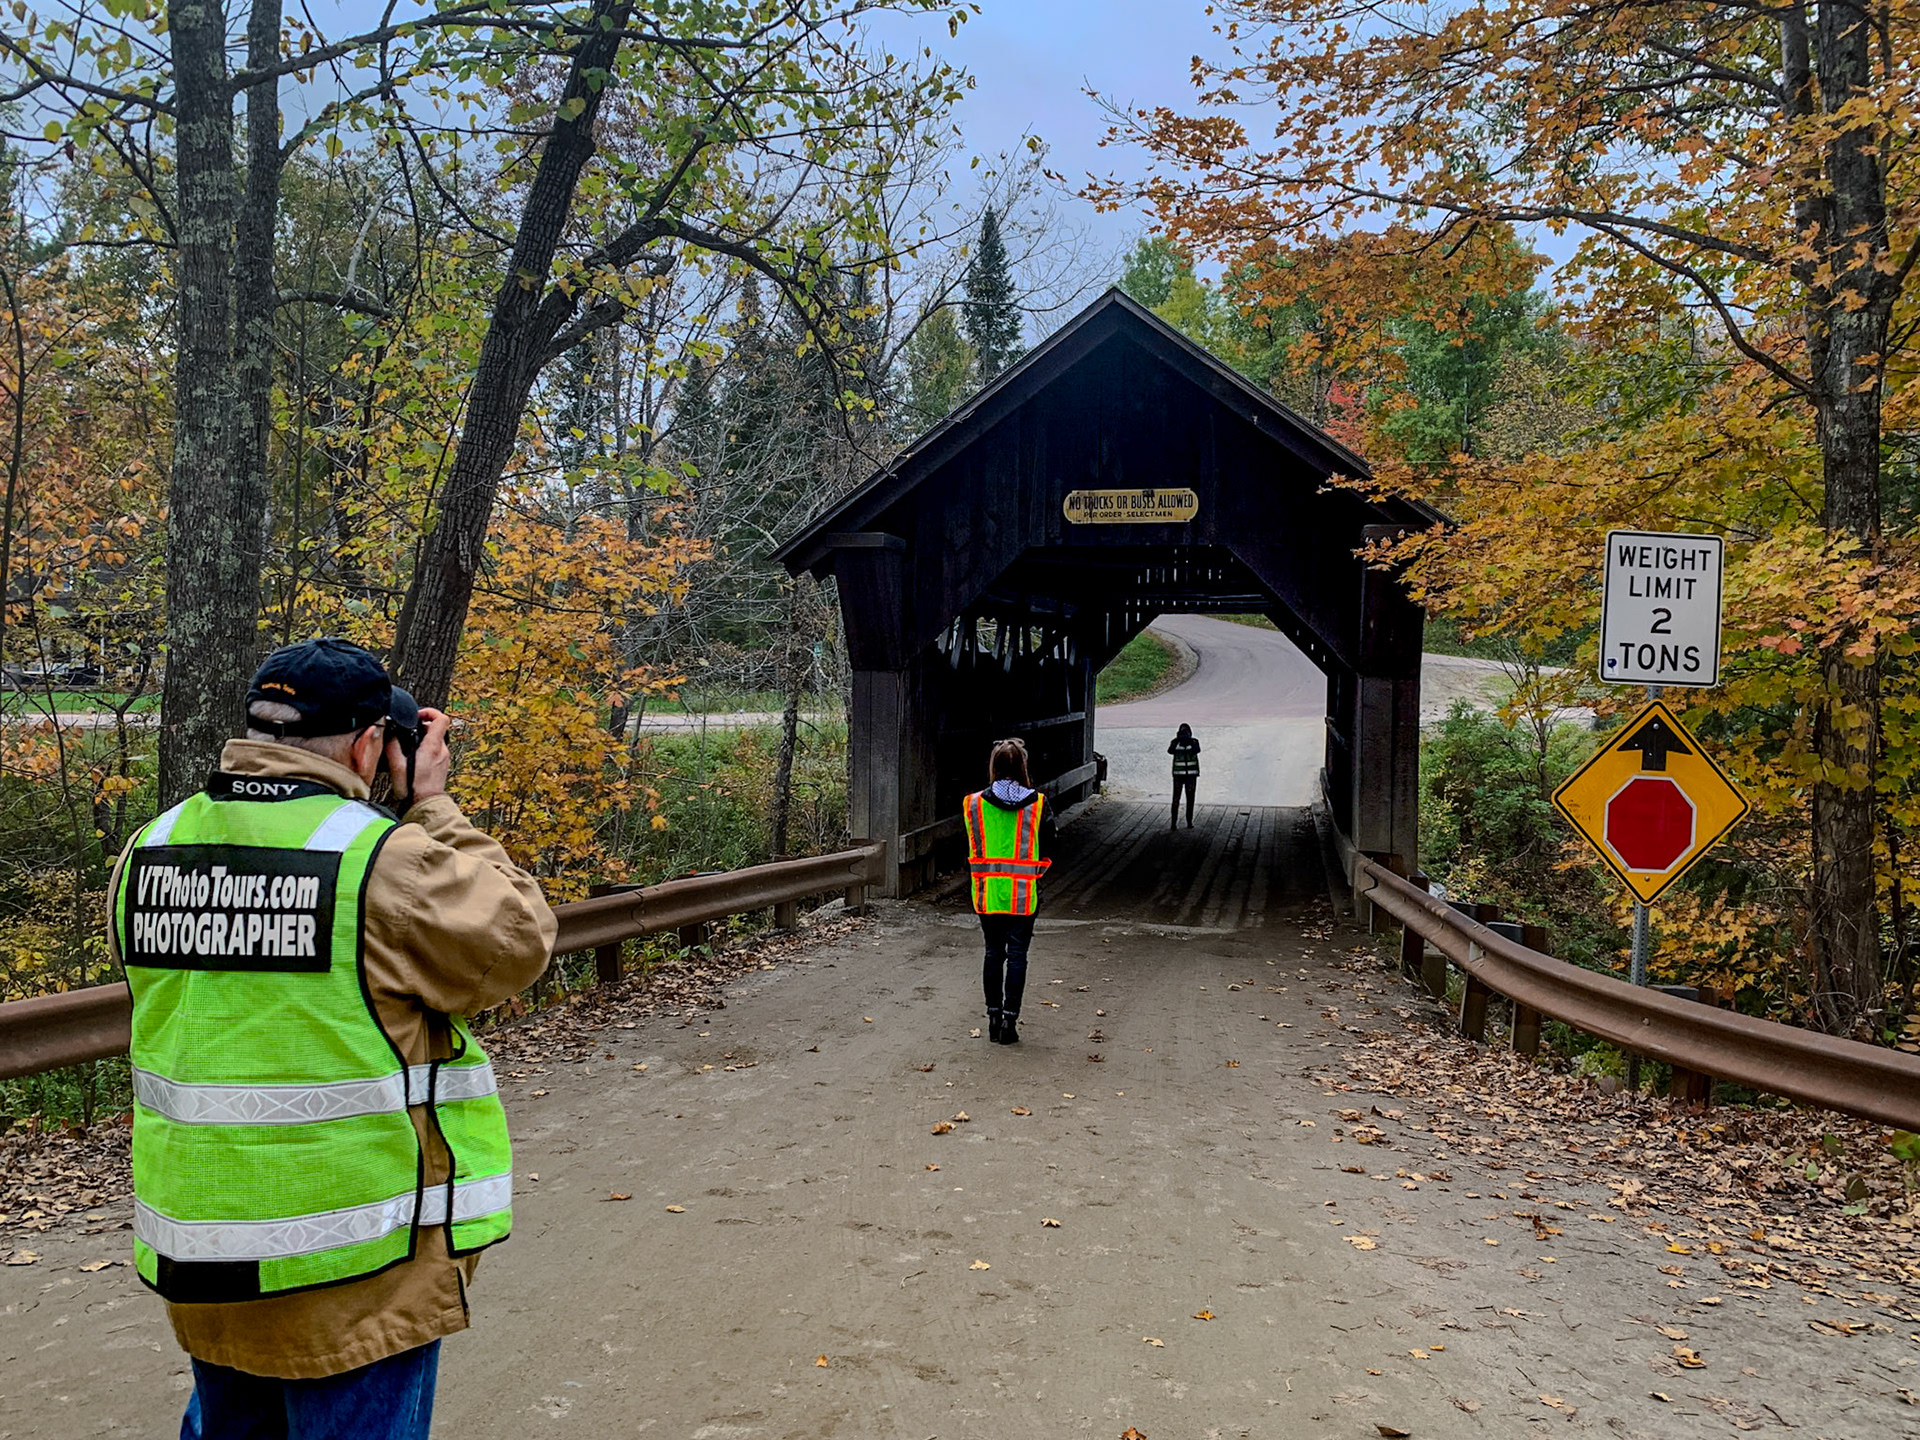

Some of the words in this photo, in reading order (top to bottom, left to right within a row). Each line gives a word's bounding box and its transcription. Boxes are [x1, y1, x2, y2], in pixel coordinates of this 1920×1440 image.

[1069, 496, 1080, 510] NO
[1083, 495, 1114, 510] TRUCKS
[1116, 495, 1128, 509] OR
[1131, 494, 1155, 509] BUSES
[1158, 494, 1193, 508] ALLOWED
[1126, 510, 1173, 518] SELECTMEN
[1619, 545, 1711, 571] WEIGHT
[1629, 575, 1697, 600] LIMIT
[1650, 607, 1672, 634] 2
[1619, 642, 1700, 672] TONS
[232, 780, 299, 796] SONY
[137, 865, 320, 909] VTPhotoTours.com
[133, 912, 316, 957] PHOTOGRAPHER
